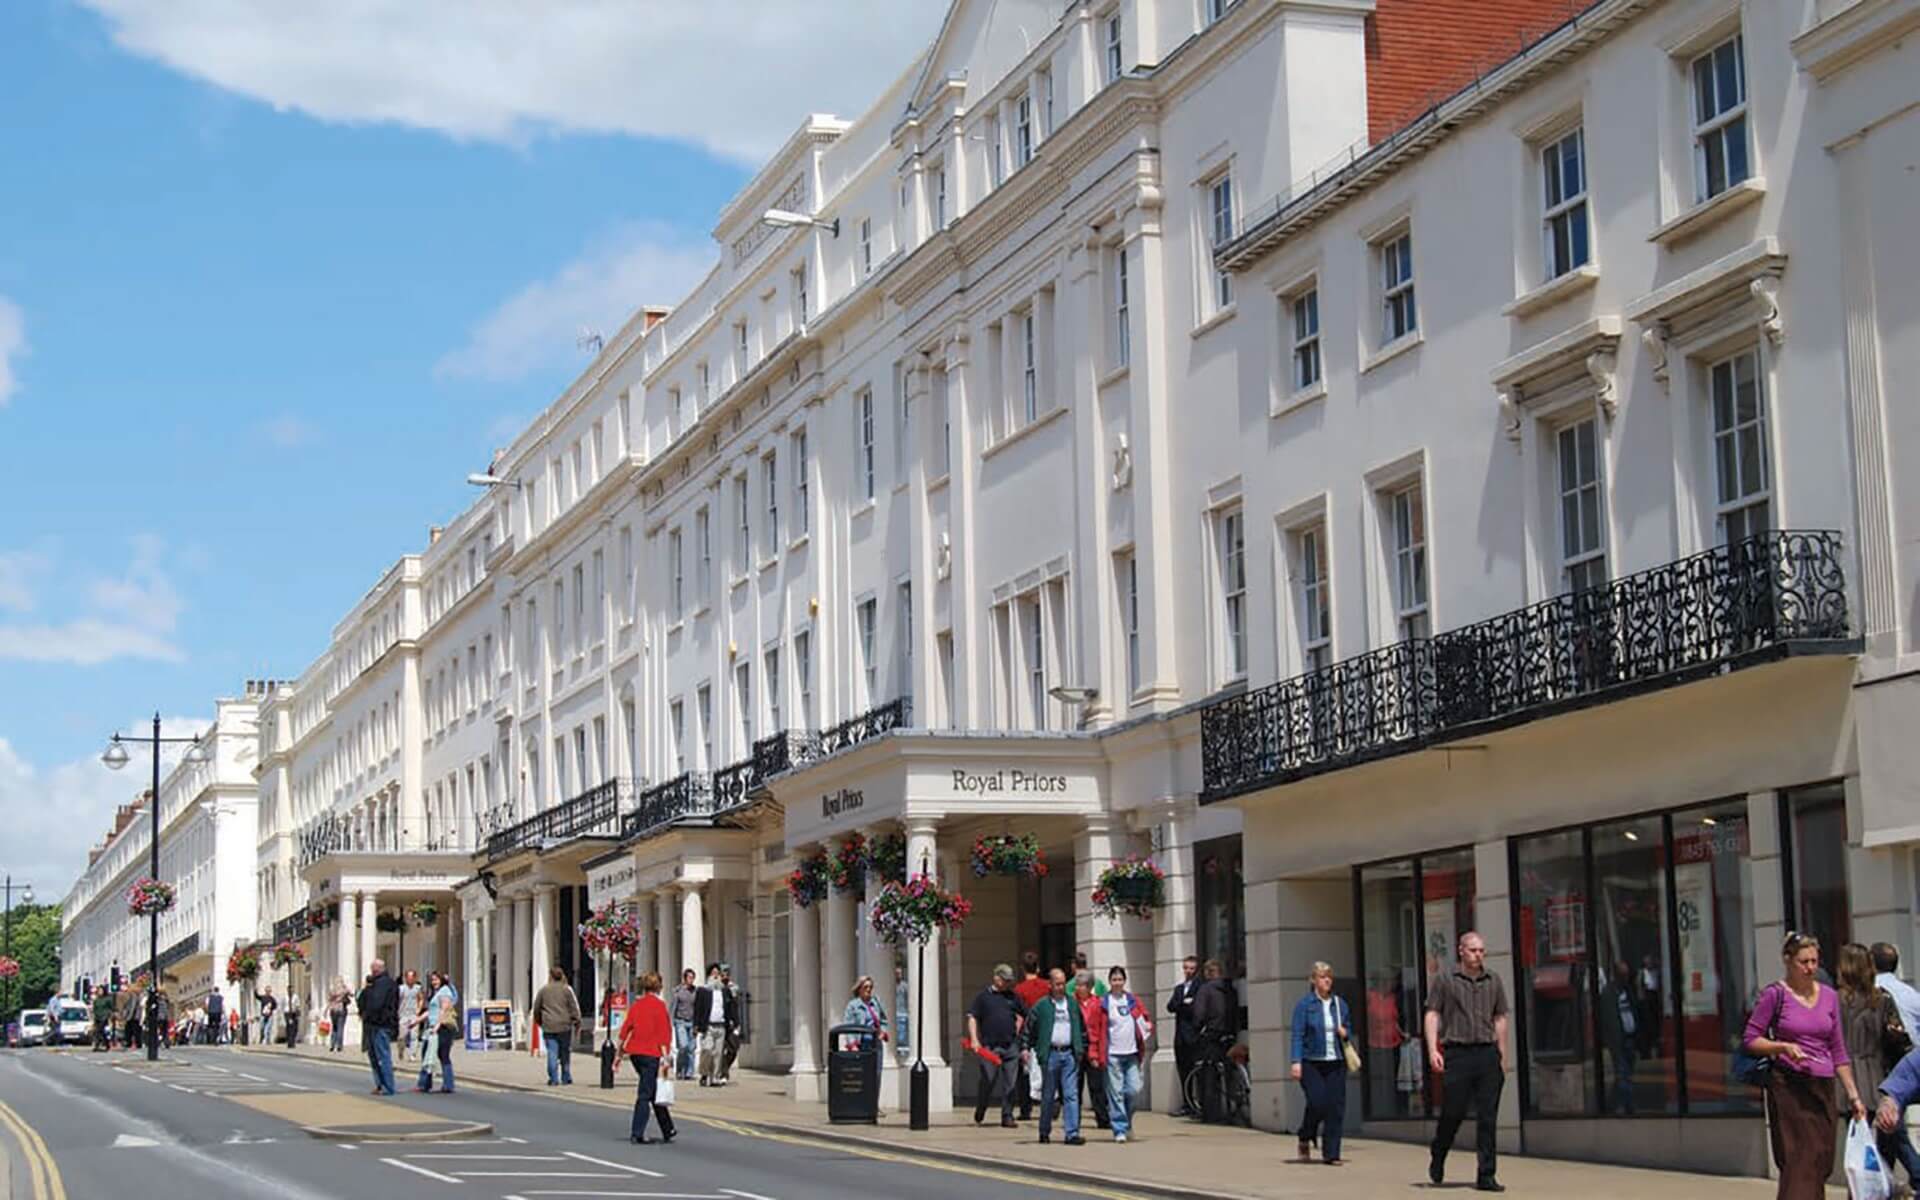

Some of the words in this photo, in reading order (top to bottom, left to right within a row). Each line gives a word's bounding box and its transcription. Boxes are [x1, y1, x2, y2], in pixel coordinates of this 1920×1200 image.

[952, 769, 1004, 795] Royal
[1011, 769, 1066, 791] Priors
[822, 790, 841, 820] Royal
